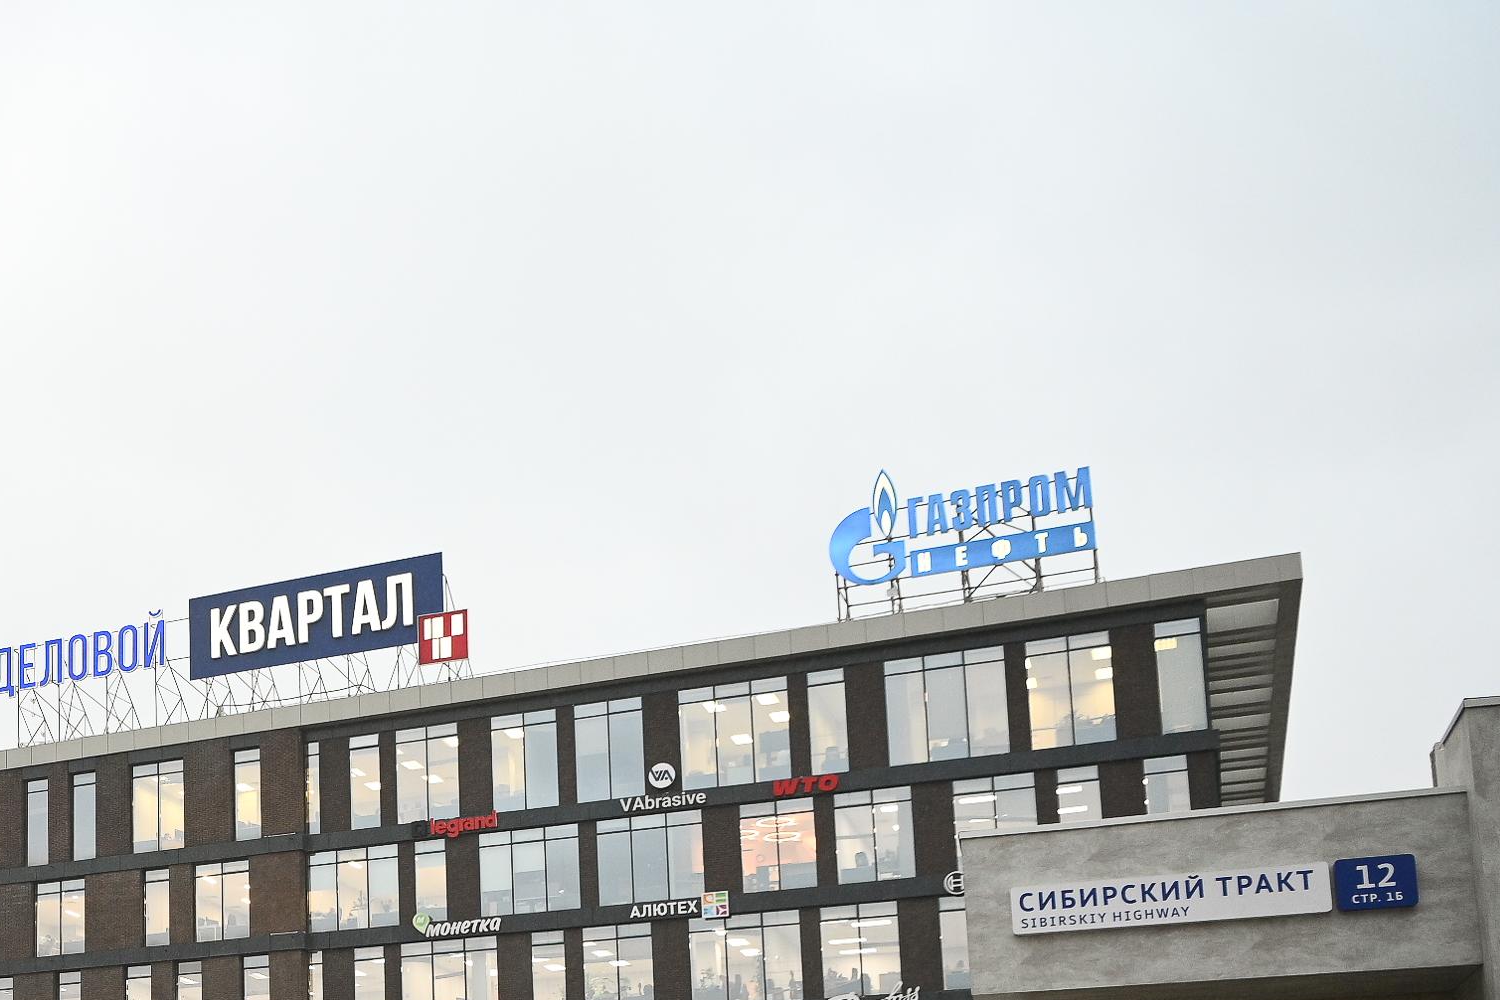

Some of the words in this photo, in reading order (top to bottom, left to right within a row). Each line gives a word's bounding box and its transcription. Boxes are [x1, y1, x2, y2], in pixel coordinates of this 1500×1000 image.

[907, 466, 1093, 538] ГАЗПРОМ
[916, 527, 1089, 573] НЕФТЬ
[210, 572, 414, 659] КВАРТАЛ
[772, 774, 840, 797] WTO
[620, 790, 707, 812] VAbrasive
[430, 810, 498, 838] legrand
[1355, 862, 1397, 889] 12
[1018, 874, 1205, 913] СИБИРСКИЙ
[1215, 869, 1315, 898] ТРАКТ
[1351, 892, 1382, 904] СТР.
[630, 899, 698, 919] АЛЮТЕХ
[1020, 912, 1107, 929] SIBIRSKIY
[1112, 906, 1191, 923] HIGHWAY
